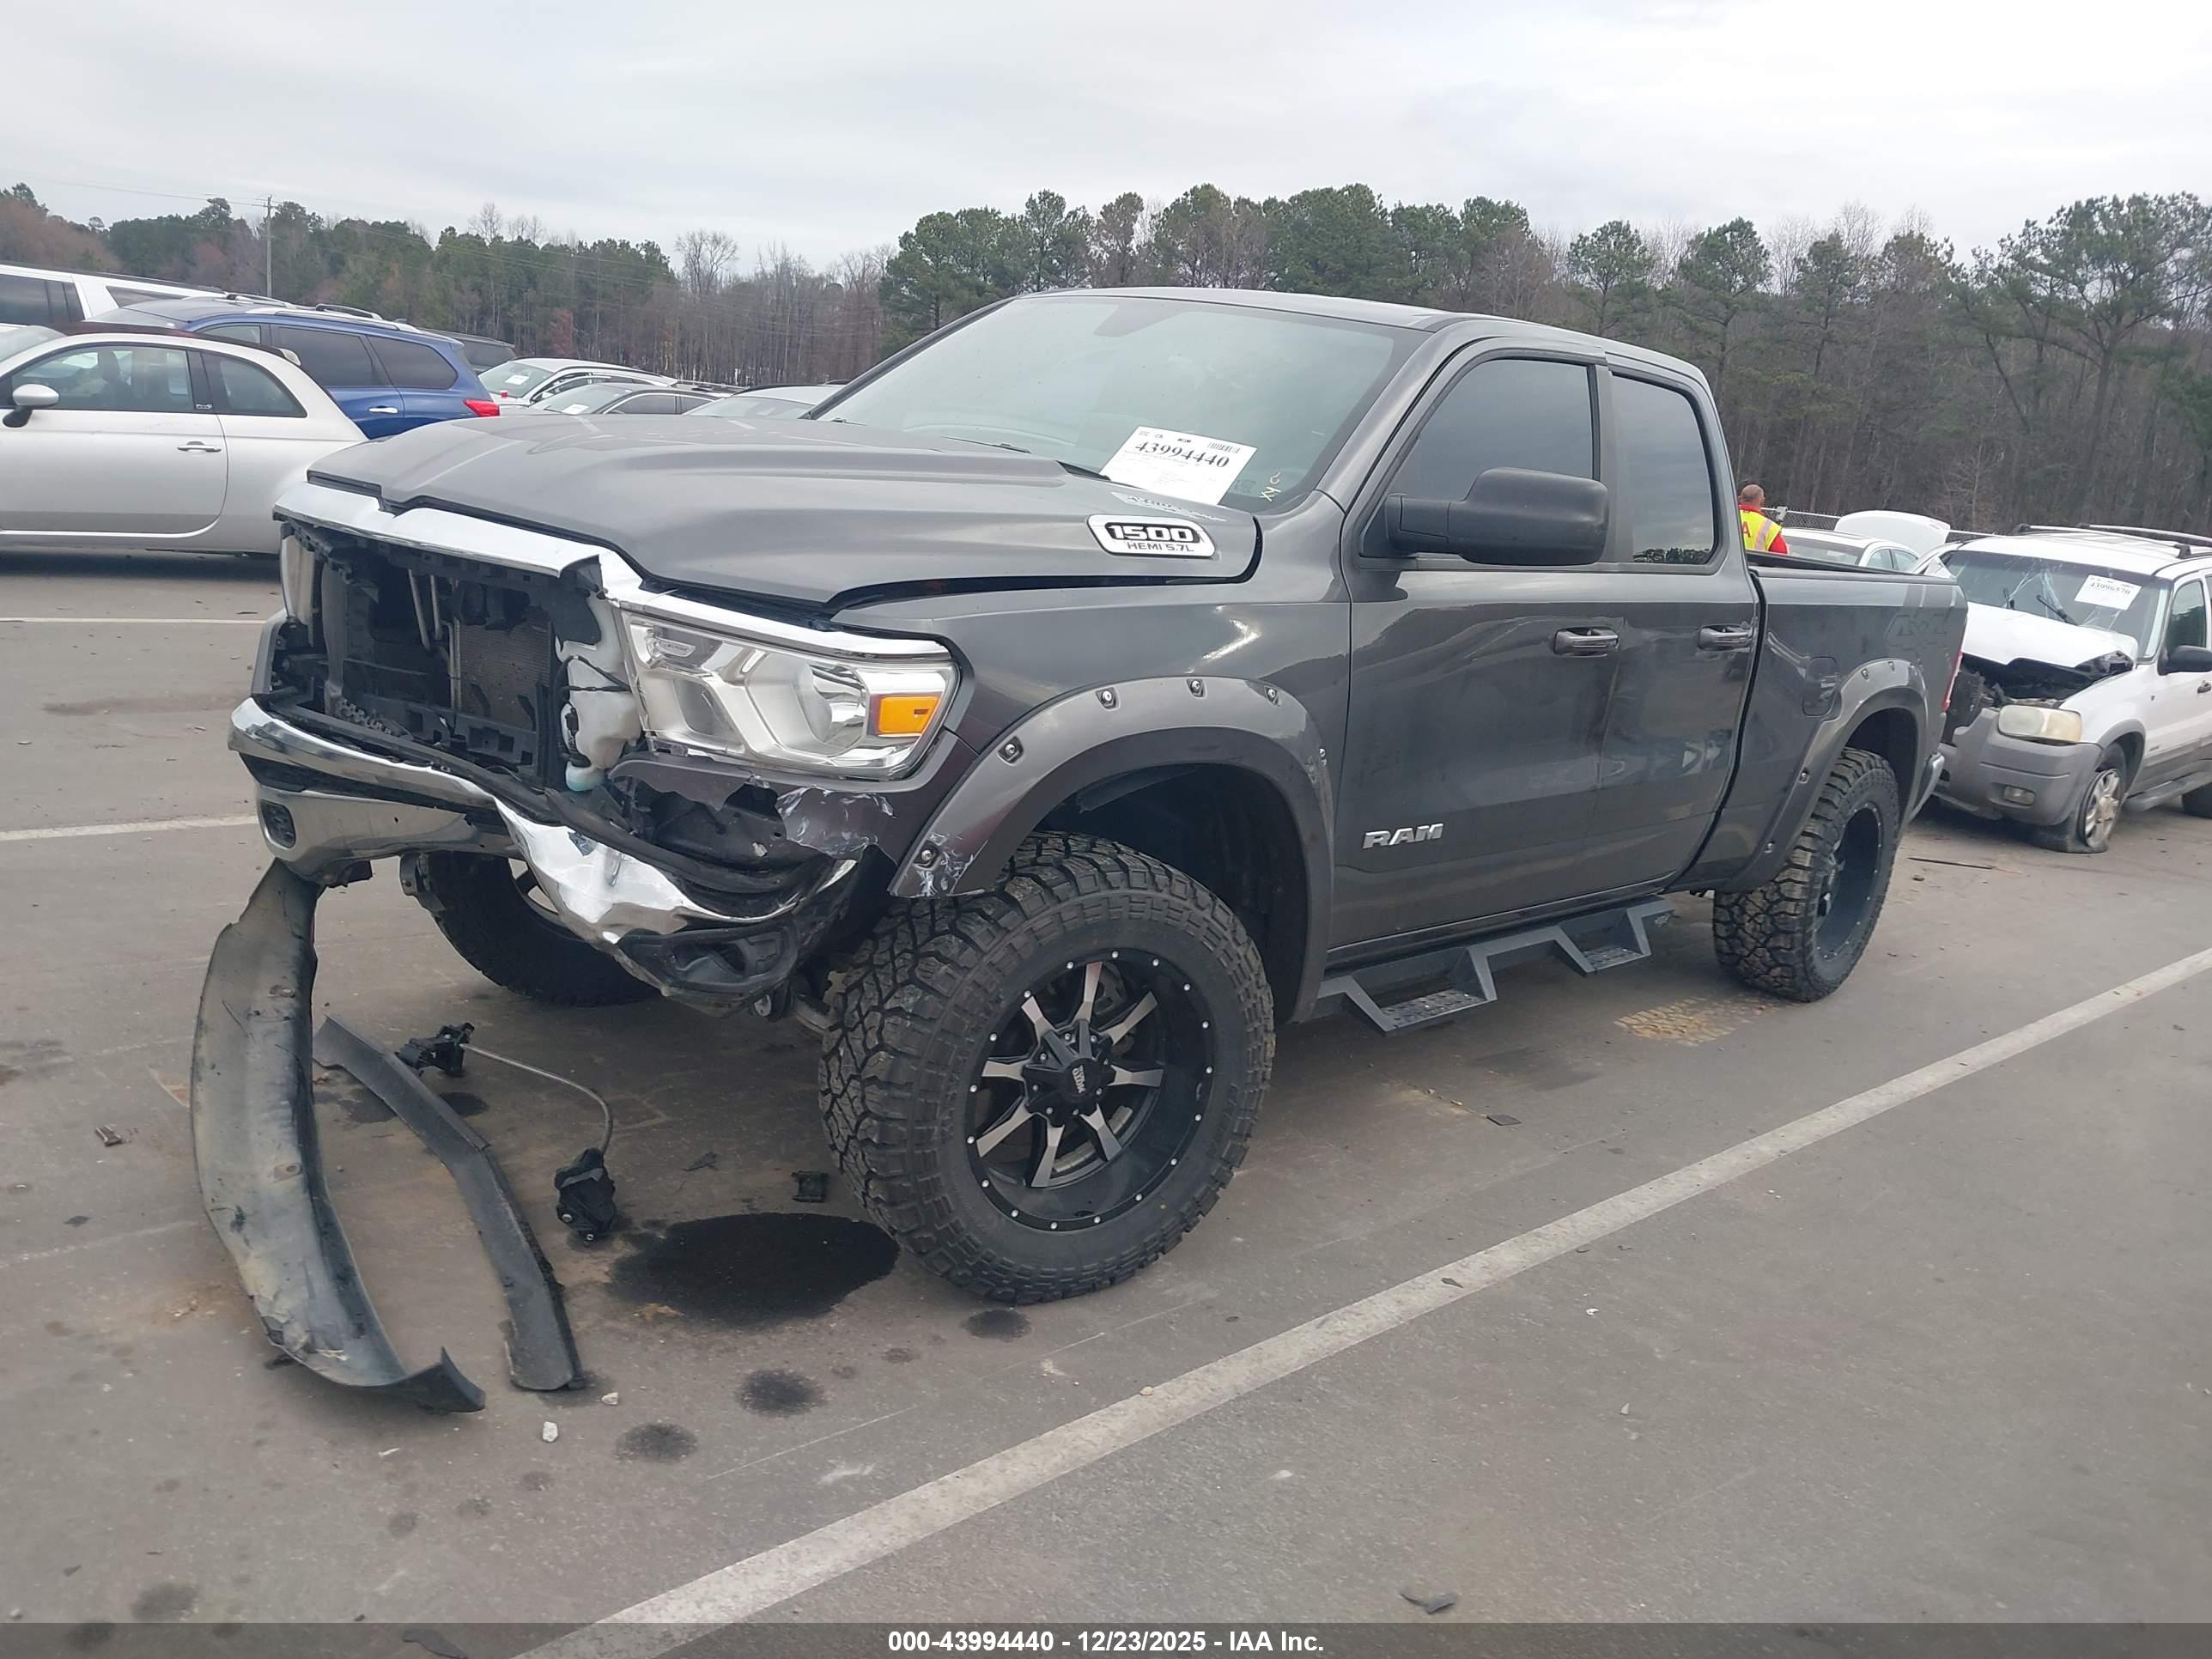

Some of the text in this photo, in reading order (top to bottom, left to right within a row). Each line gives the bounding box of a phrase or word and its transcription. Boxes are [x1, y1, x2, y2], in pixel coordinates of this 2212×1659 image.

[1135, 441, 1230, 468] 43994440
[1106, 523, 1194, 541] 1500
[1127, 542, 1194, 552] HEMI 5.7L
[1362, 823, 1444, 849] RAM
